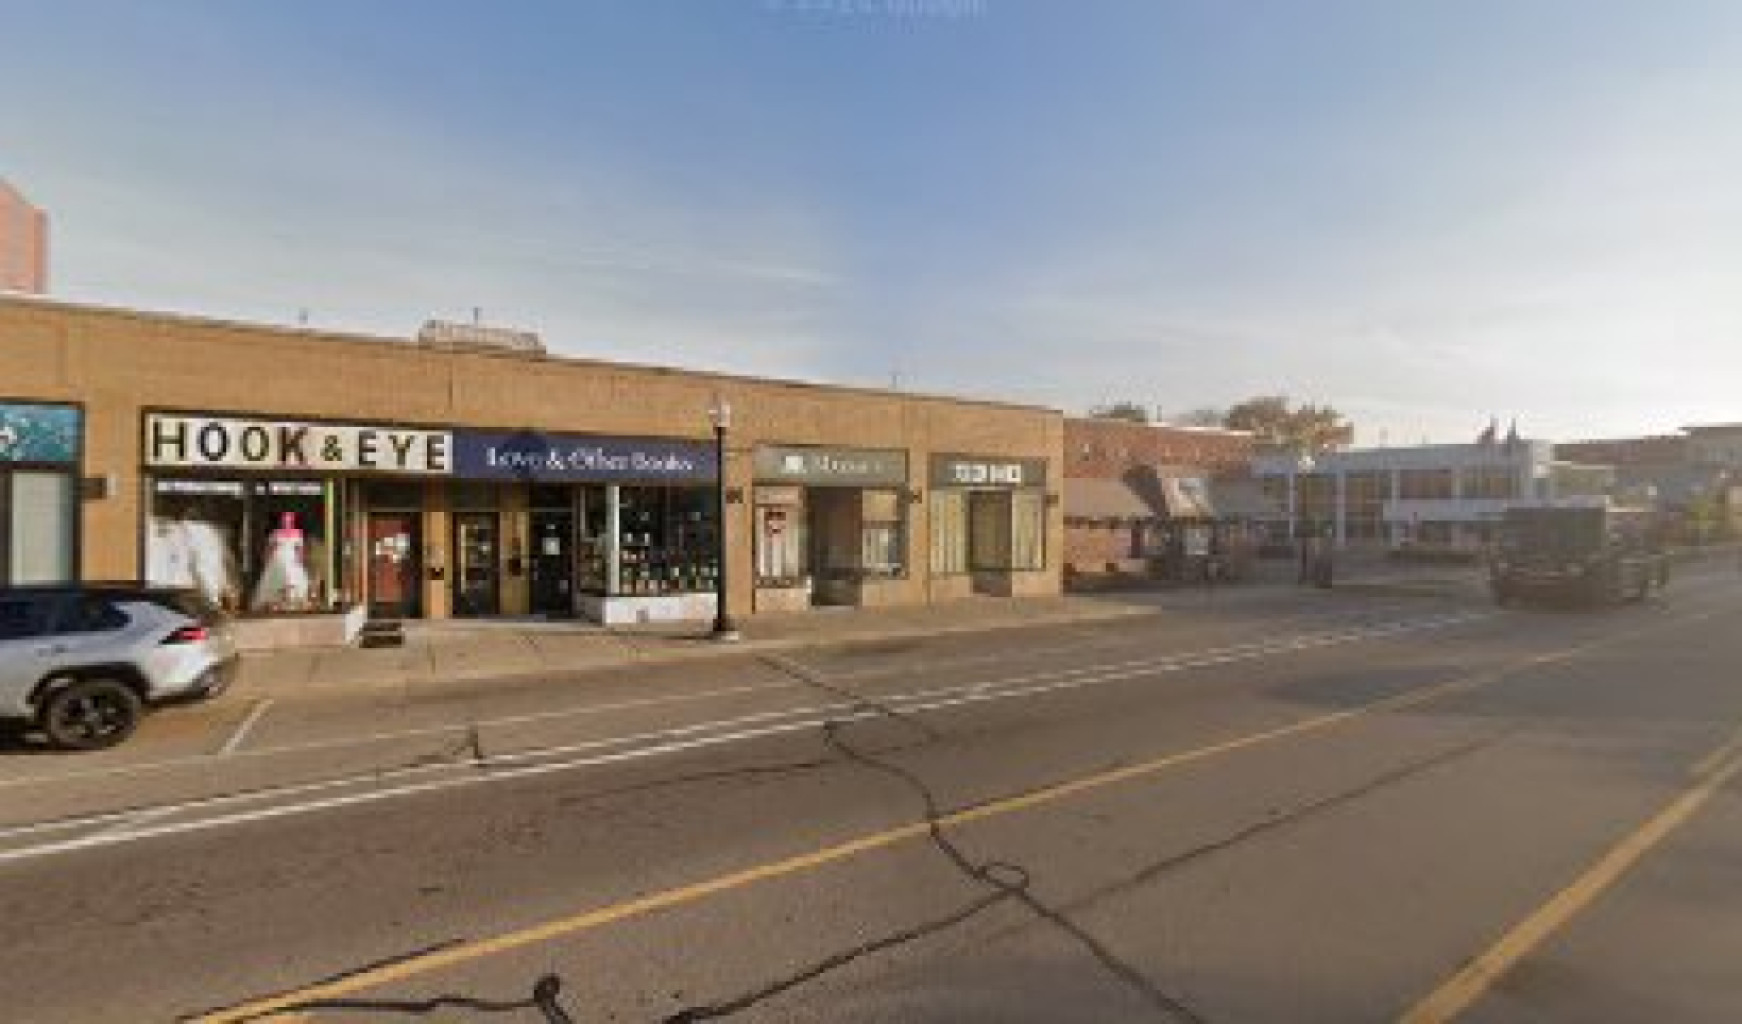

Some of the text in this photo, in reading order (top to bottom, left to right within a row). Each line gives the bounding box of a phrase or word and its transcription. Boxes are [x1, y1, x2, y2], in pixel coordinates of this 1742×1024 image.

[152, 420, 446, 470] HOOK & EYE
[545, 449, 566, 471] &
[568, 447, 628, 471] Other
[631, 451, 692, 472] Books
